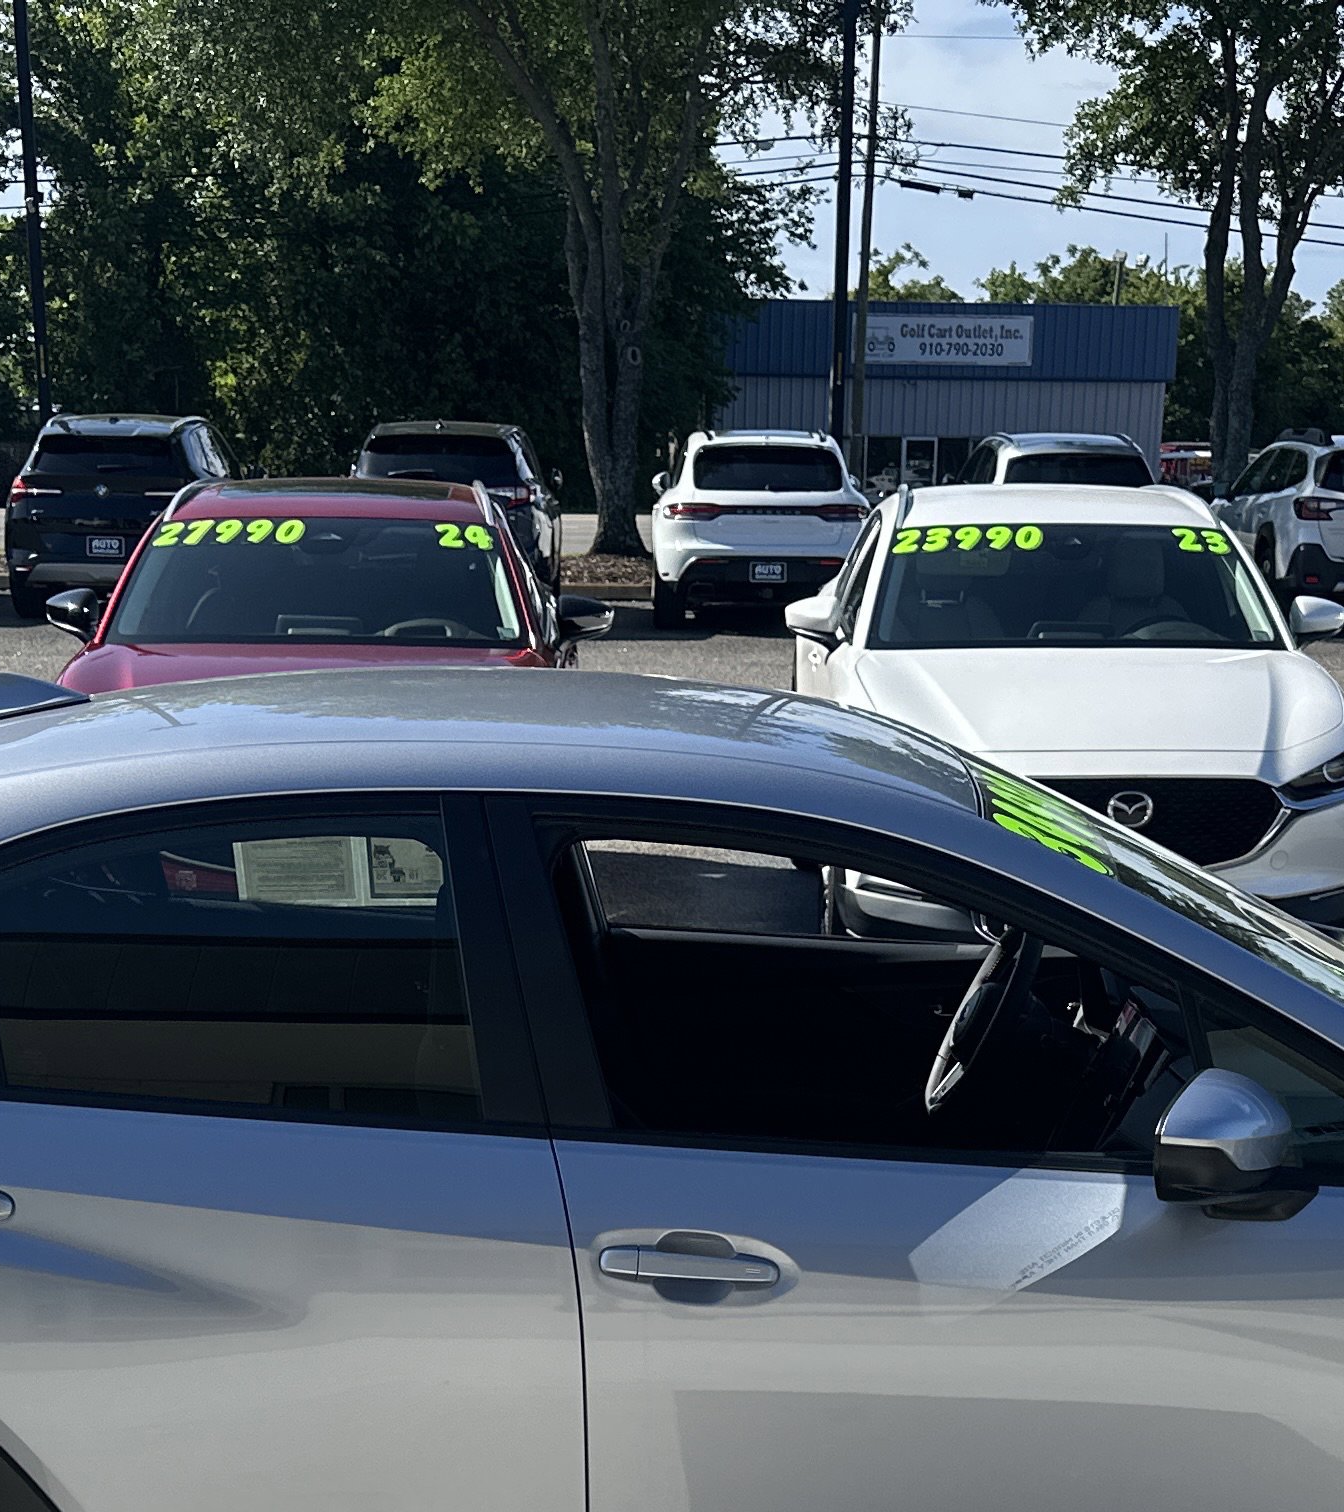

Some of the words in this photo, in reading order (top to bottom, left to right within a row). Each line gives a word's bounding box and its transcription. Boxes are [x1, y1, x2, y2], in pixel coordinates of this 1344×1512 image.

[900, 323, 927, 338] Golf
[928, 324, 953, 339] Cart
[956, 324, 998, 342] Outlet,
[999, 325, 1024, 340] Inc.
[919, 342, 1004, 357] 910-790-2030
[152, 519, 306, 547] 27990
[434, 523, 493, 550] 24
[892, 526, 1044, 554] 23990
[1171, 527, 1232, 555] 23
[92, 539, 120, 549] AUTO
[755, 564, 782, 575] AUTO
